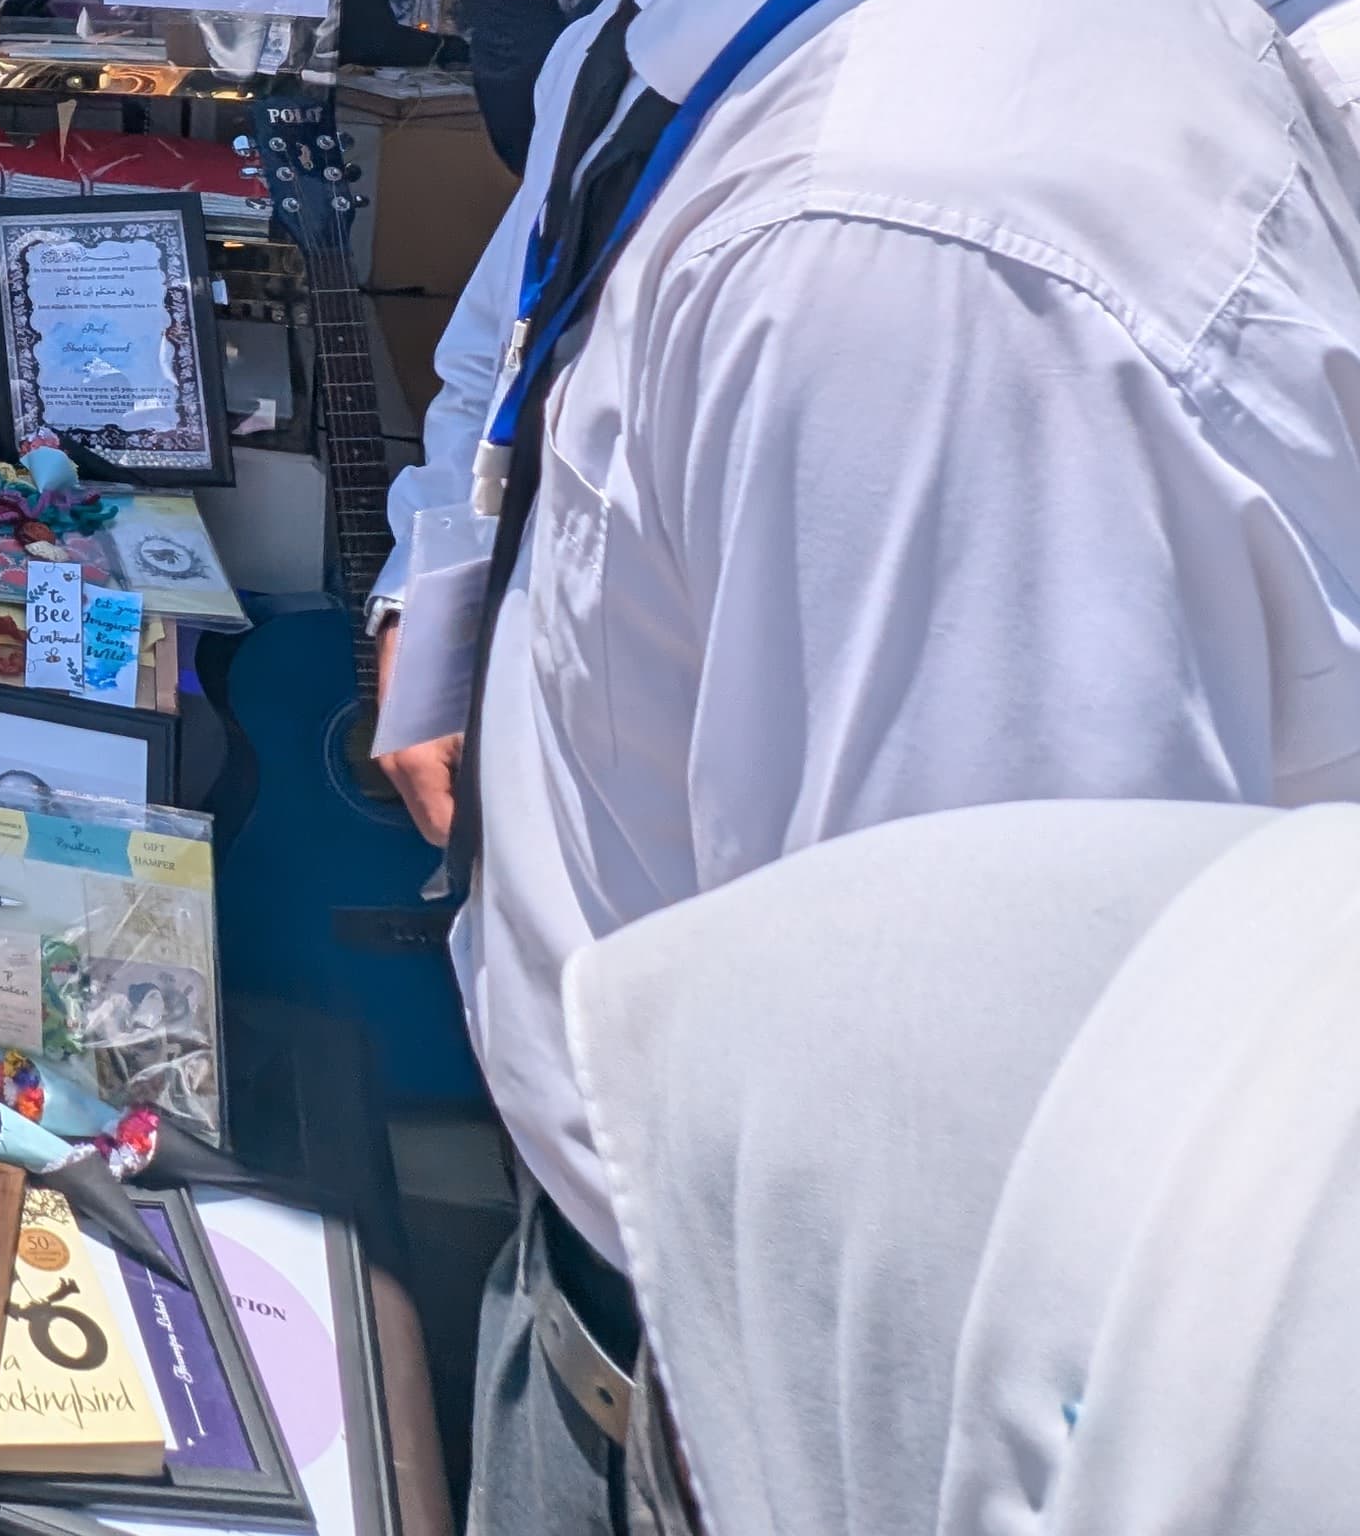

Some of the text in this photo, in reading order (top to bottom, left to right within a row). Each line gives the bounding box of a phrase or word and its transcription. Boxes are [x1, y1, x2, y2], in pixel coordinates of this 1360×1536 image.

[266, 107, 324, 125] POLO
[48, 588, 66, 604] to
[34, 604, 74, 623] Bee
[143, 842, 166, 854] GIFT
[133, 855, 176, 871] HAMPER
[3, 1354, 21, 1372] a
